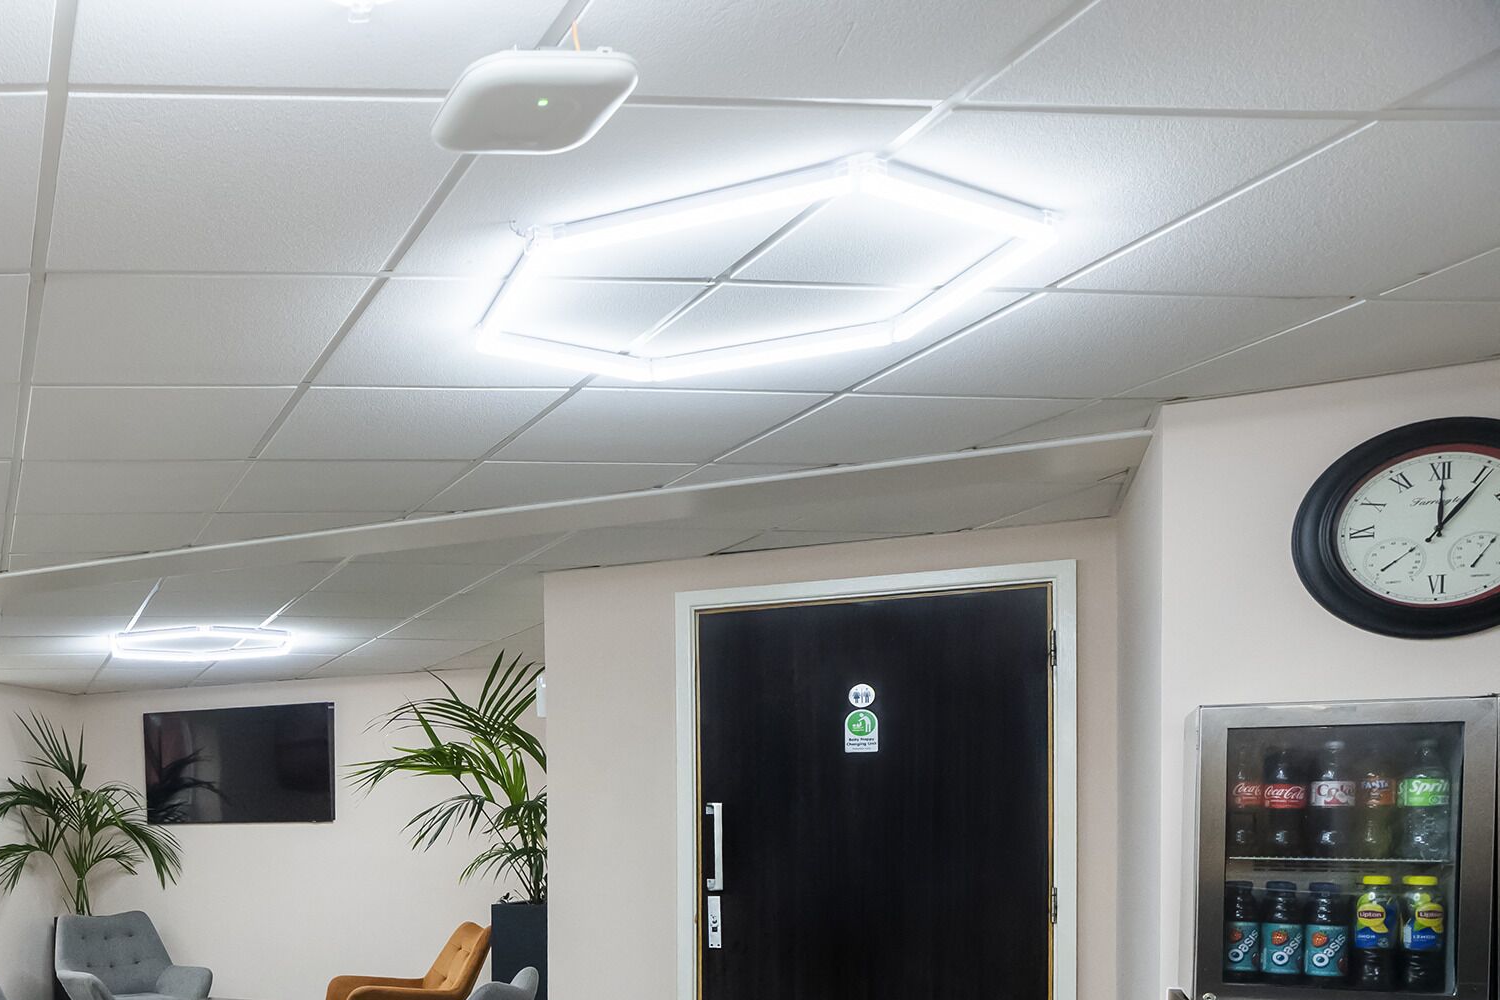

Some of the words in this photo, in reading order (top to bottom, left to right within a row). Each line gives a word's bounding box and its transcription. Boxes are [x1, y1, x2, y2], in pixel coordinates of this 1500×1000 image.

[1428, 461, 1452, 482] XII
[1389, 472, 1414, 493] XI
[1428, 574, 1447, 595] VI
[1264, 785, 1305, 800] Coca-Cola
[1409, 779, 1449, 795] Sprit
[1359, 911, 1382, 919] Lipton
[1228, 929, 1259, 962] Oasis
[1272, 932, 1303, 966] Oasis
[1312, 934, 1346, 967] Oasis
